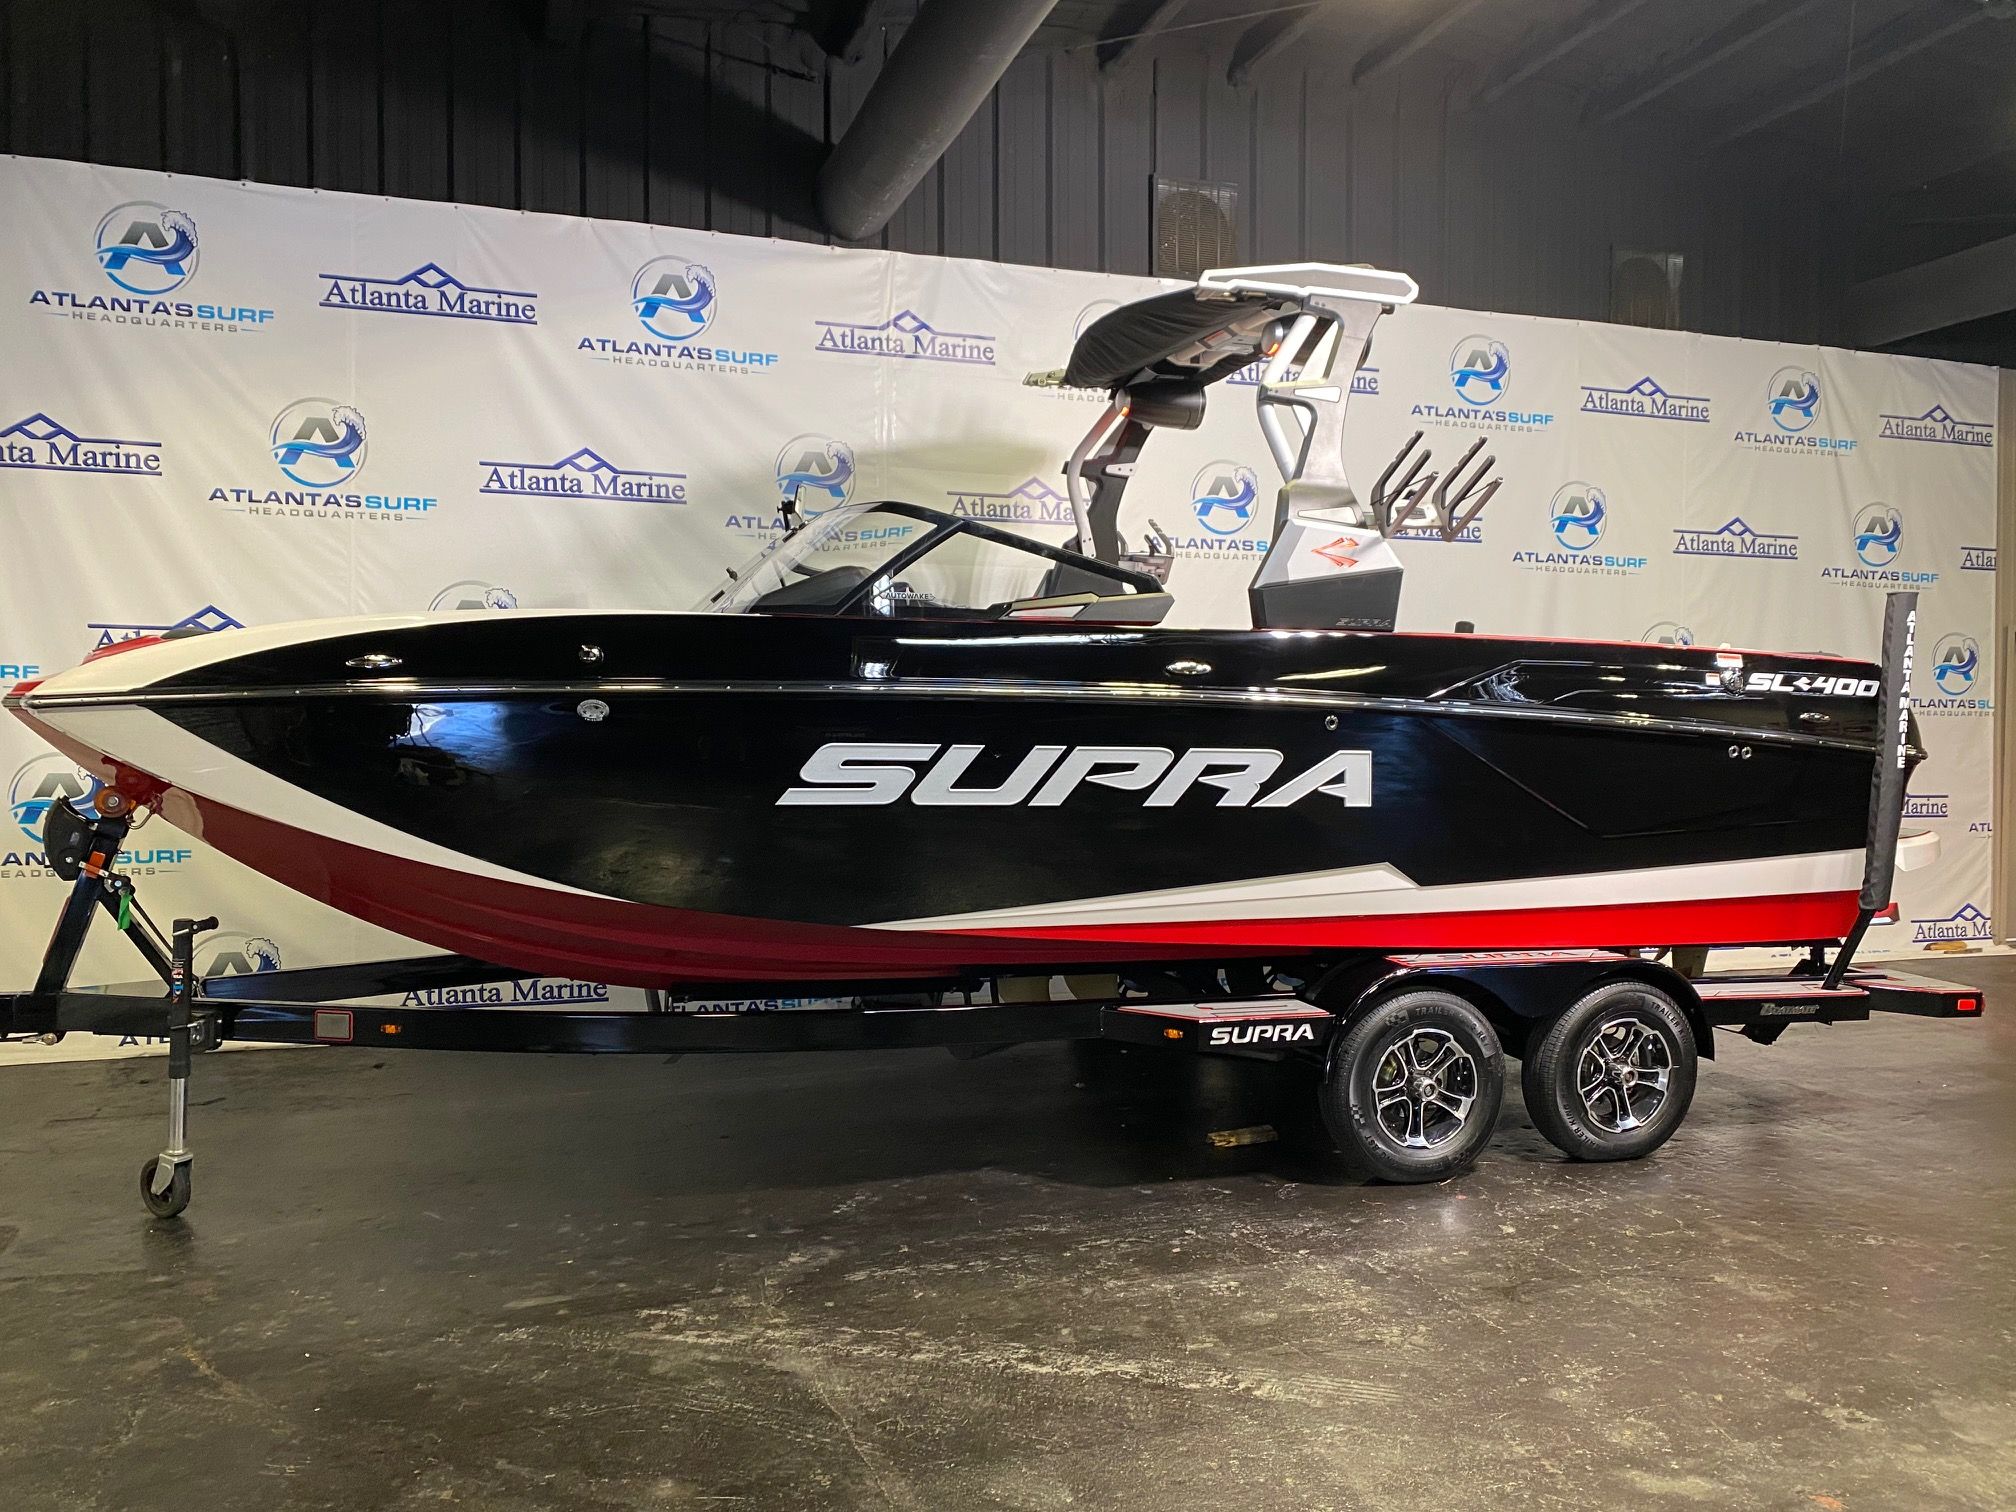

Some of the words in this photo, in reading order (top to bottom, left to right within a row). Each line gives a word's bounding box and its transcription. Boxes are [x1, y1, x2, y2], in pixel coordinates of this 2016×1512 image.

[323, 280, 428, 310] Atlanta
[437, 290, 536, 319] Marine
[72, 311, 237, 332] HEADQUARTERS
[818, 326, 905, 353] Atlanta
[912, 335, 995, 361] Marine
[612, 355, 749, 374] HEADQUARTERS
[1583, 391, 1645, 413] Atlanta
[1650, 397, 1710, 419] Marine
[1435, 419, 1533, 432] HEADQUARTERS
[1881, 418, 1937, 438] Atlanta
[1941, 423, 1993, 444] Marine
[46, 441, 160, 471] Marine
[483, 467, 583, 493] Atlanta
[592, 473, 686, 499] Marine
[248, 506, 403, 521] HEADQUARTERS
[951, 496, 1032, 519] Atlanta
[1675, 533, 1735, 553] Atlanta
[1740, 537, 1798, 556] Marine
[1535, 566, 1627, 576] HEADQUARTERS
[885, 592, 929, 600] AUTOWAKE
[1901, 610, 1916, 694] ATLANTA
[1919, 710, 1995, 718] HEADQUARTER
[1896, 697, 1910, 769] MARINE
[775, 742, 1372, 807] SUPRA
[1915, 922, 1968, 939] Atlanta
[401, 984, 503, 1007] Atlanta
[511, 979, 609, 1002] Marine
[1651, 1001, 1680, 1028] TRAILER
[1210, 1023, 1315, 1045] SUPRA
